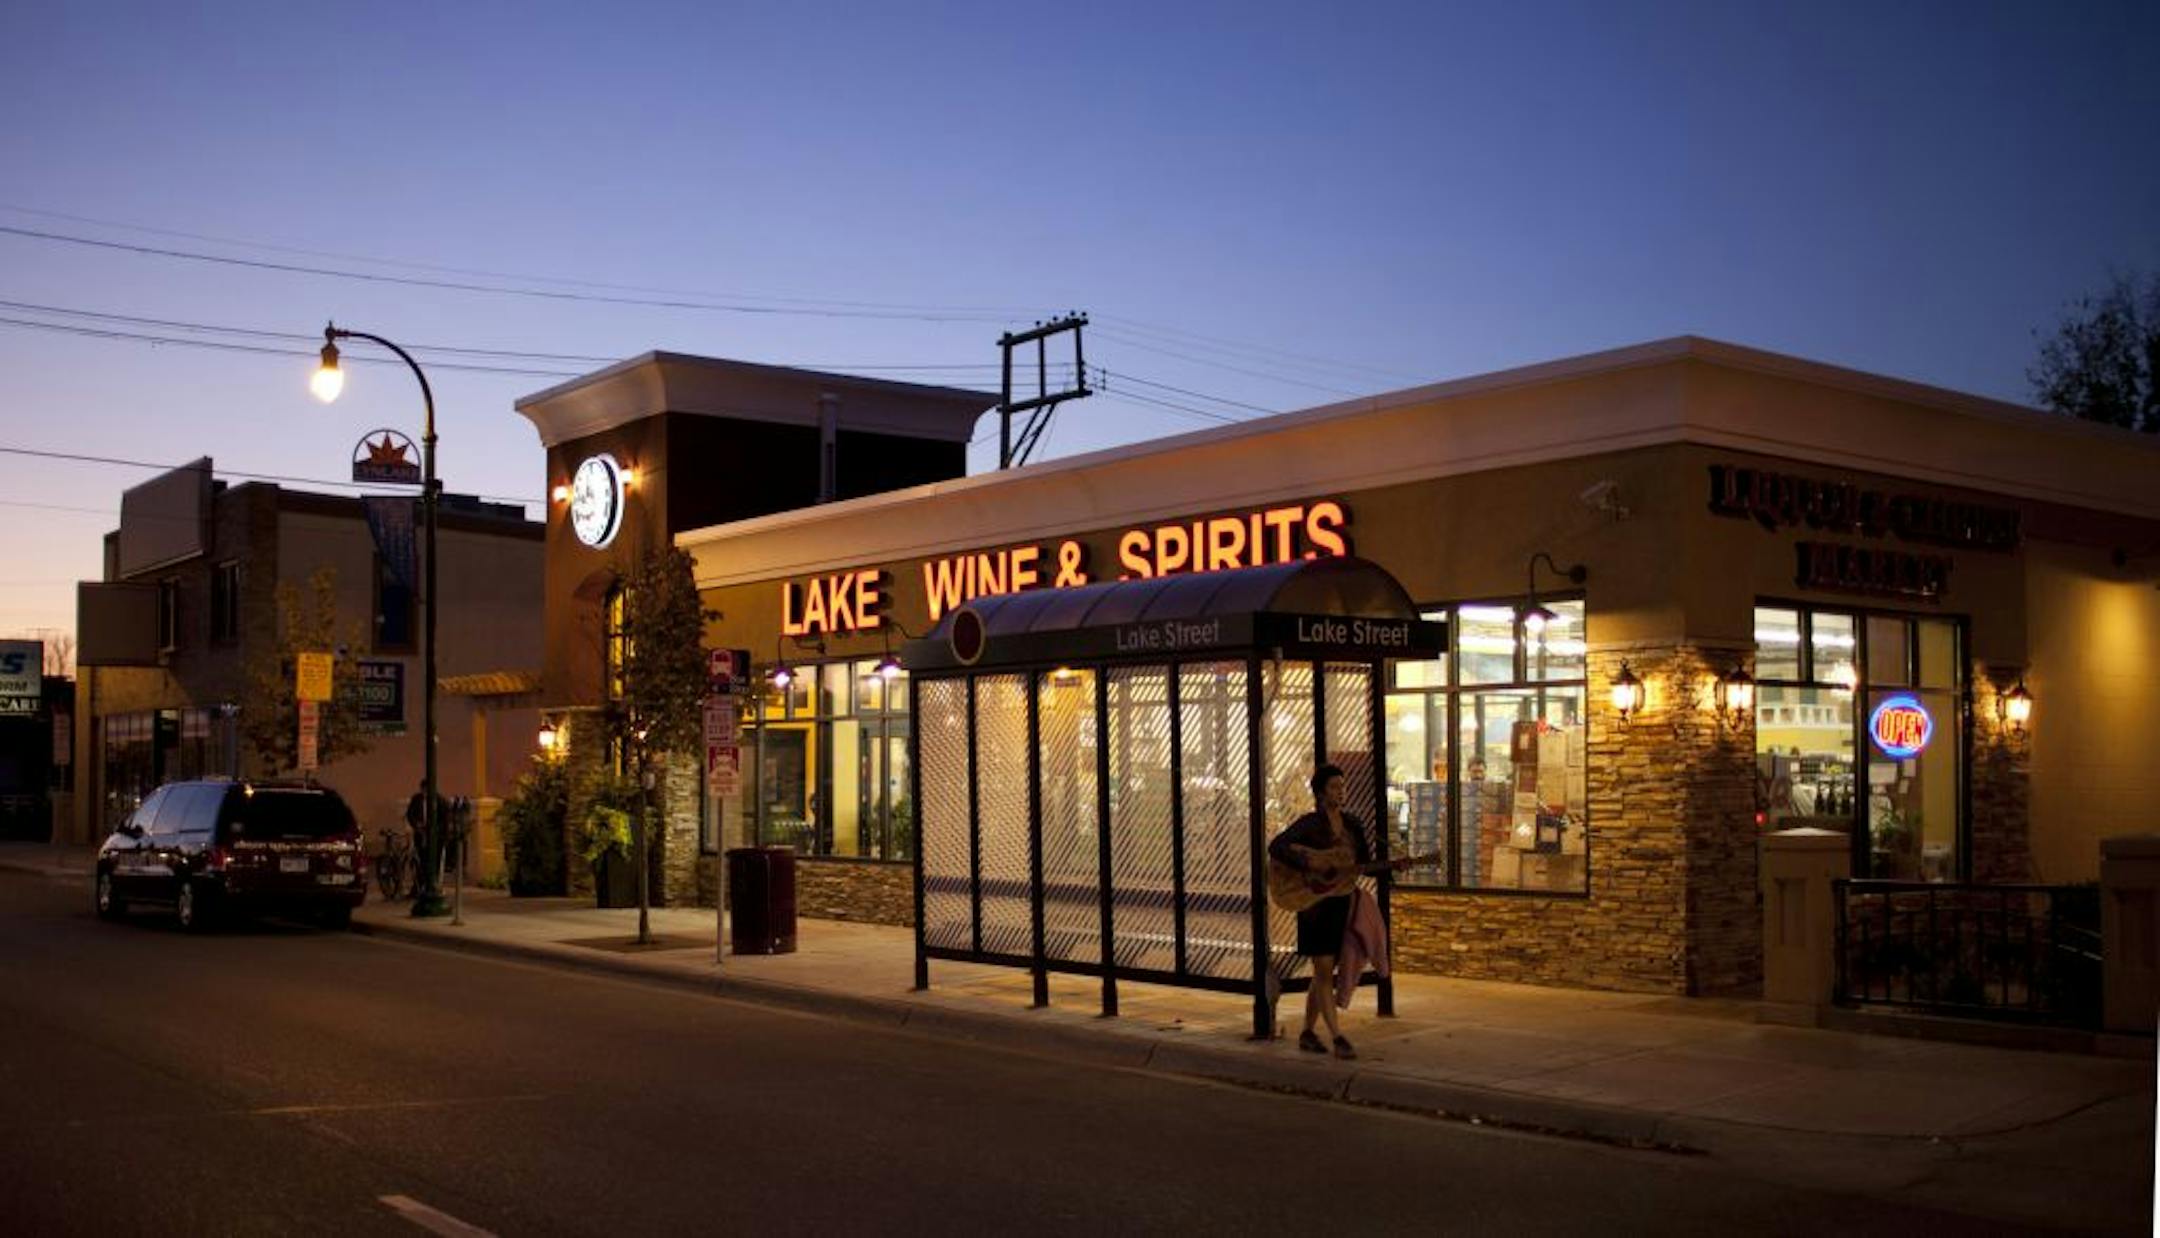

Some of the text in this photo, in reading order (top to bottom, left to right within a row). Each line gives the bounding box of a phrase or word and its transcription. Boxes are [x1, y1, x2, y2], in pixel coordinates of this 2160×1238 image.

[783, 501, 1347, 636] LAKE WINE & SPIRITS
[1116, 618, 1220, 650] Lake Street
[1299, 616, 1411, 647] Lake Street
[1879, 708, 1924, 747] OPEN
